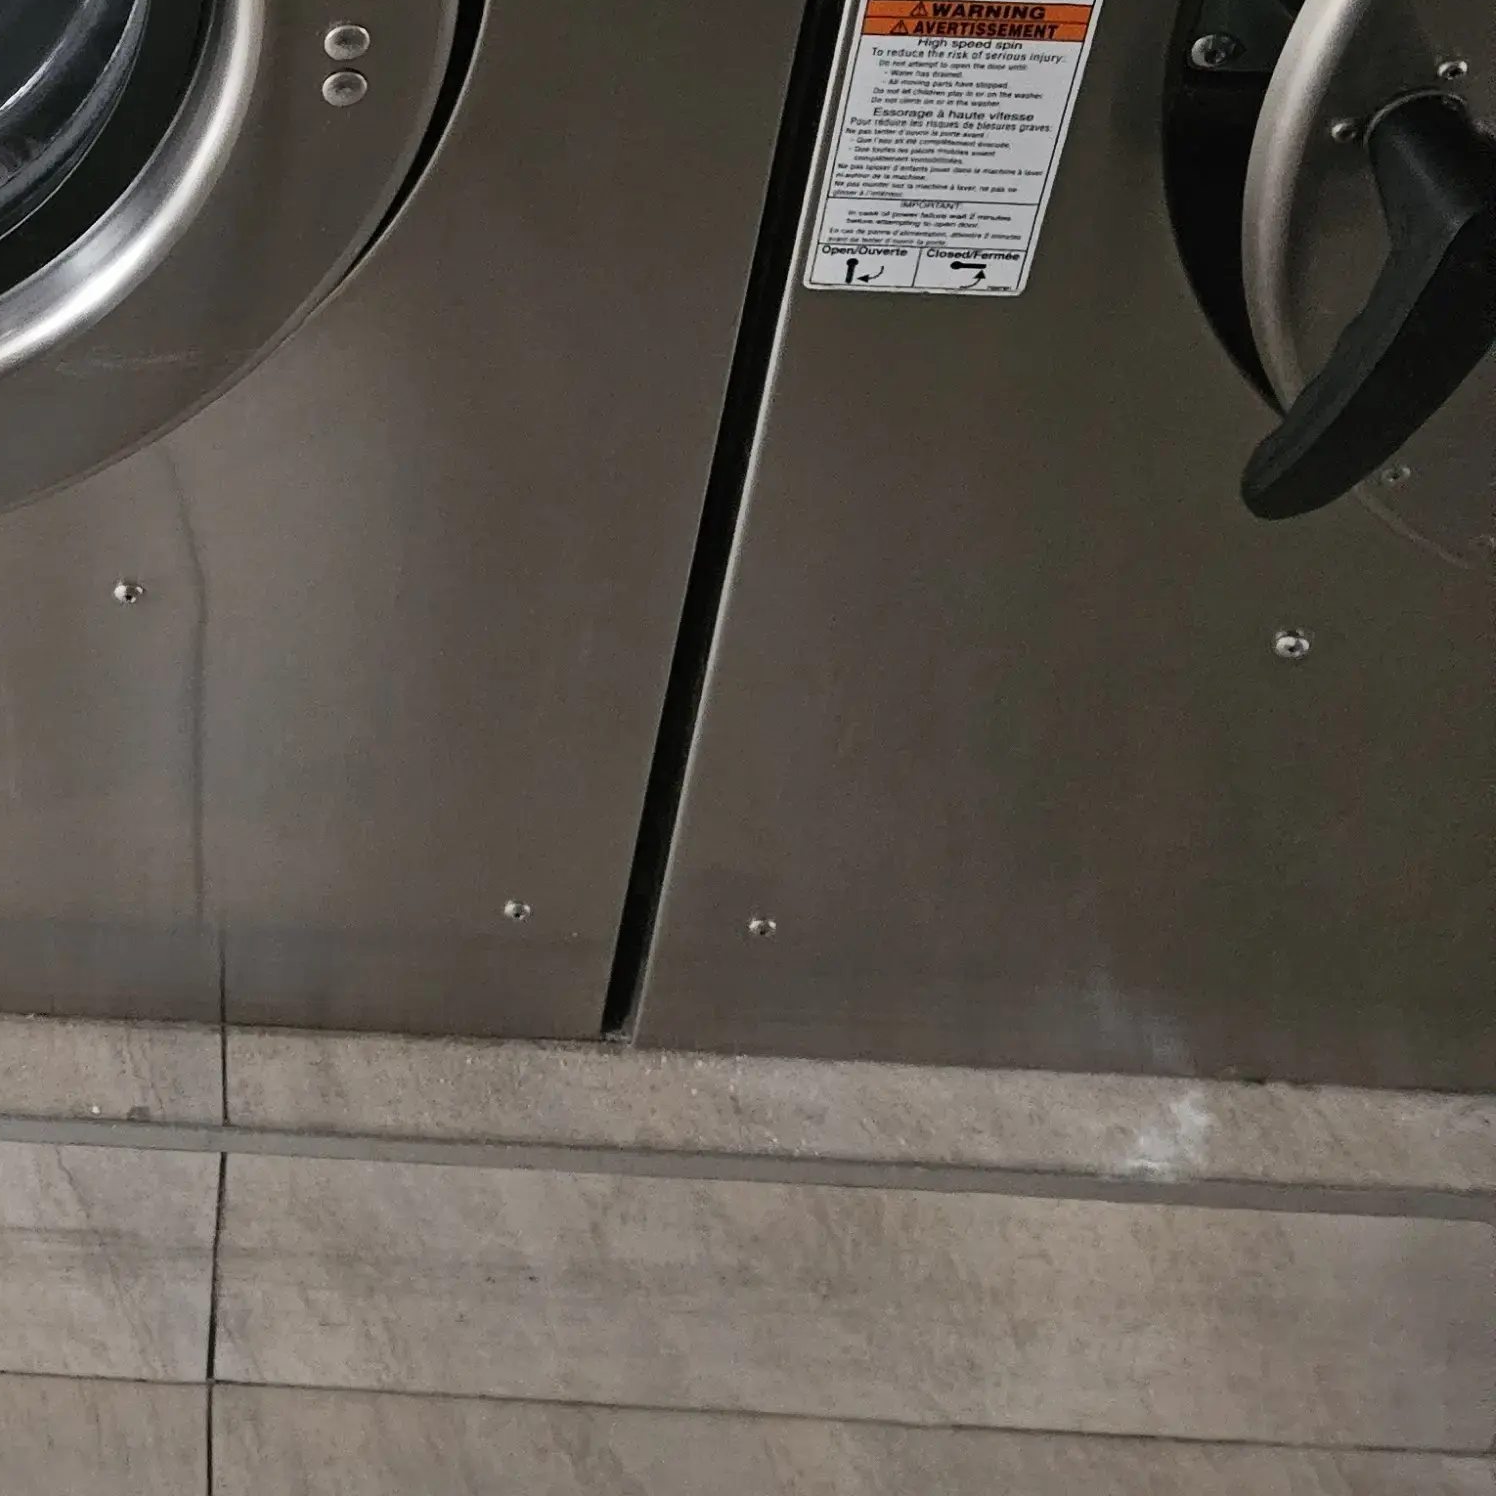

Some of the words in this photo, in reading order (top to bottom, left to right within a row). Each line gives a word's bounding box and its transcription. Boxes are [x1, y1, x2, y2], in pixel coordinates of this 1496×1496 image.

[931, 3, 1045, 20] WARNING
[913, 21, 1059, 39] AVERTISSEMENT
[917, 37, 947, 49] High
[951, 39, 992, 50] speed
[995, 40, 1023, 51] spin
[871, 46, 884, 56] To
[886, 47, 924, 57] reduce
[927, 48, 945, 58] the
[947, 49, 968, 59] risk
[971, 50, 984, 60] of
[985, 51, 1026, 62] serious
[873, 106, 933, 119] Essorage
[937, 109, 945, 119] à
[948, 109, 985, 120] haute
[989, 111, 1034, 122] vitesse
[822, 245, 909, 257] Open/Ouverte
